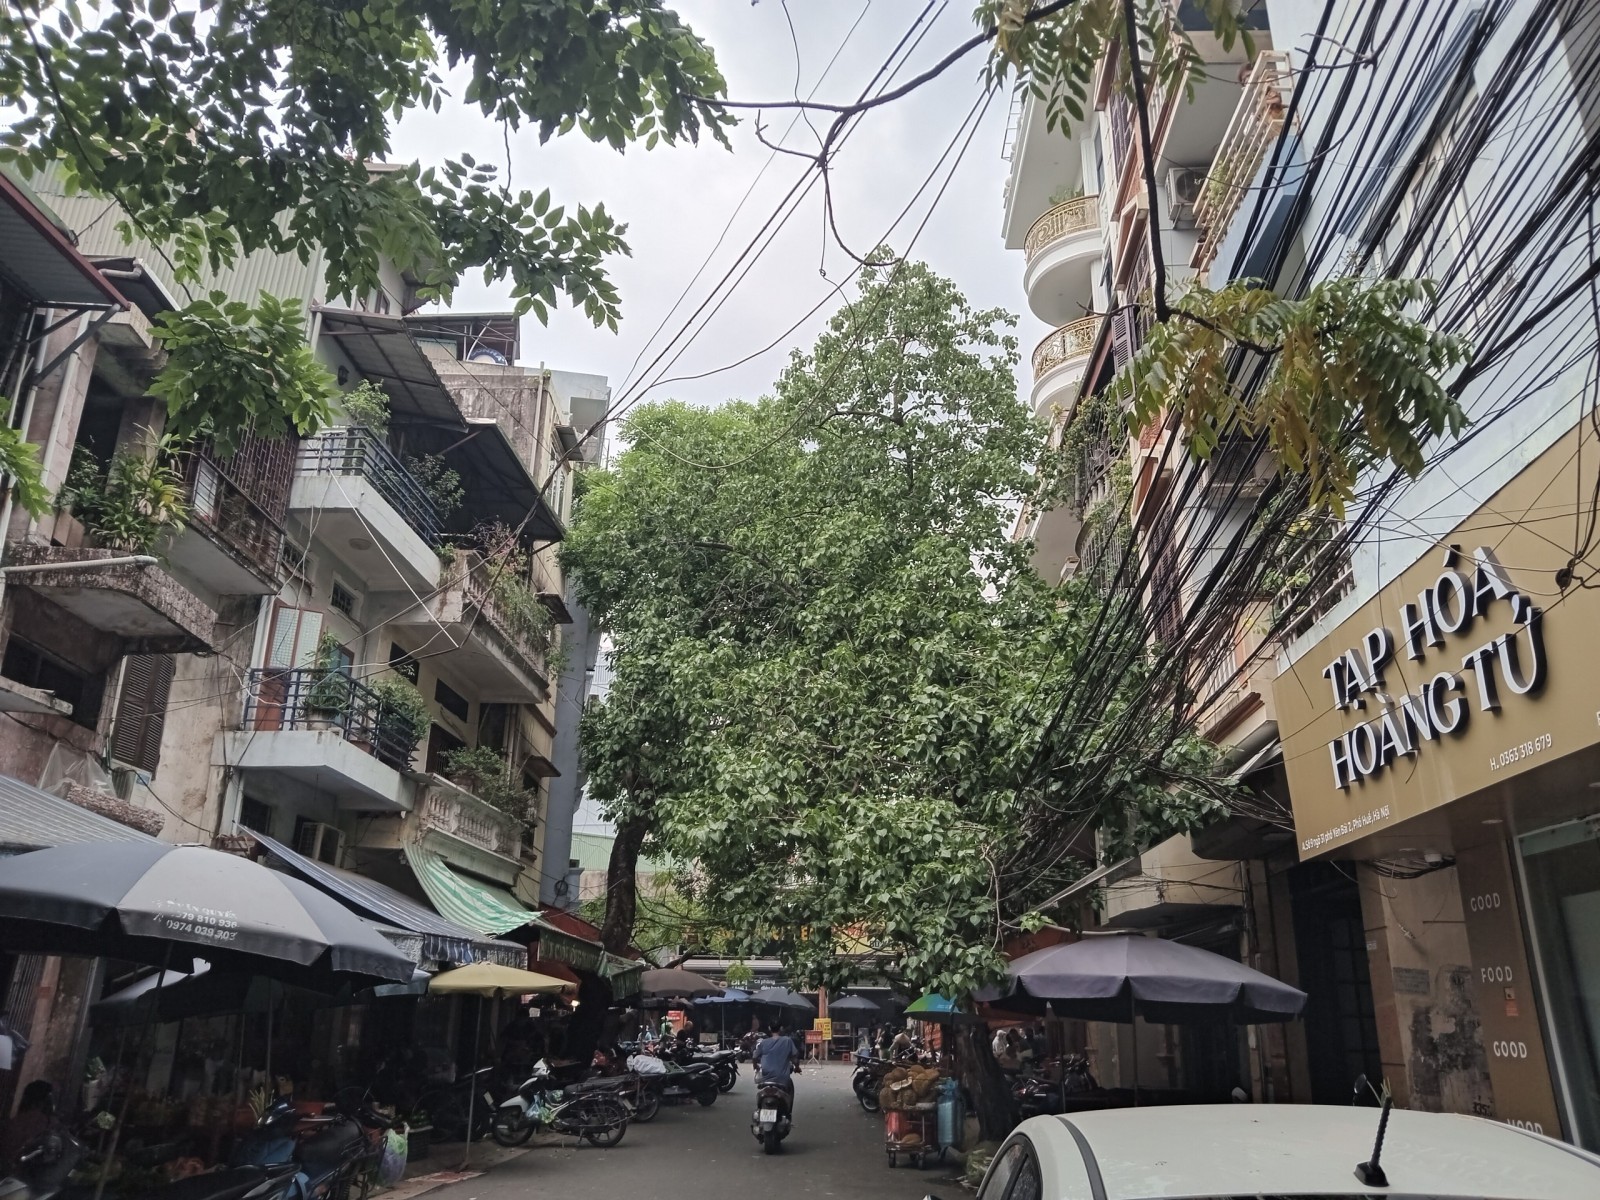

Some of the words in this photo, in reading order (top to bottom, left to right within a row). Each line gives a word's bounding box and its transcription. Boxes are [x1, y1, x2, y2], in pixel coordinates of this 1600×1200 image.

[1322, 627, 1392, 710] TẠP
[1399, 545, 1520, 660] HÓA
[1328, 670, 1469, 789] HOÀNG
[1462, 595, 1548, 712] TỬ
[1499, 747, 1519, 766] 0363
[1520, 741, 1534, 758] 318
[1535, 733, 1552, 751] 679
[1380, 804, 1390, 820] Nội
[1470, 892, 1501, 912] GOOD
[166, 920, 193, 932] 0974
[194, 925, 214, 936] 039
[197, 914, 216, 925] 810
[218, 919, 238, 928] 936
[1481, 965, 1513, 983] FOOD
[1493, 1041, 1527, 1058] GOOD
